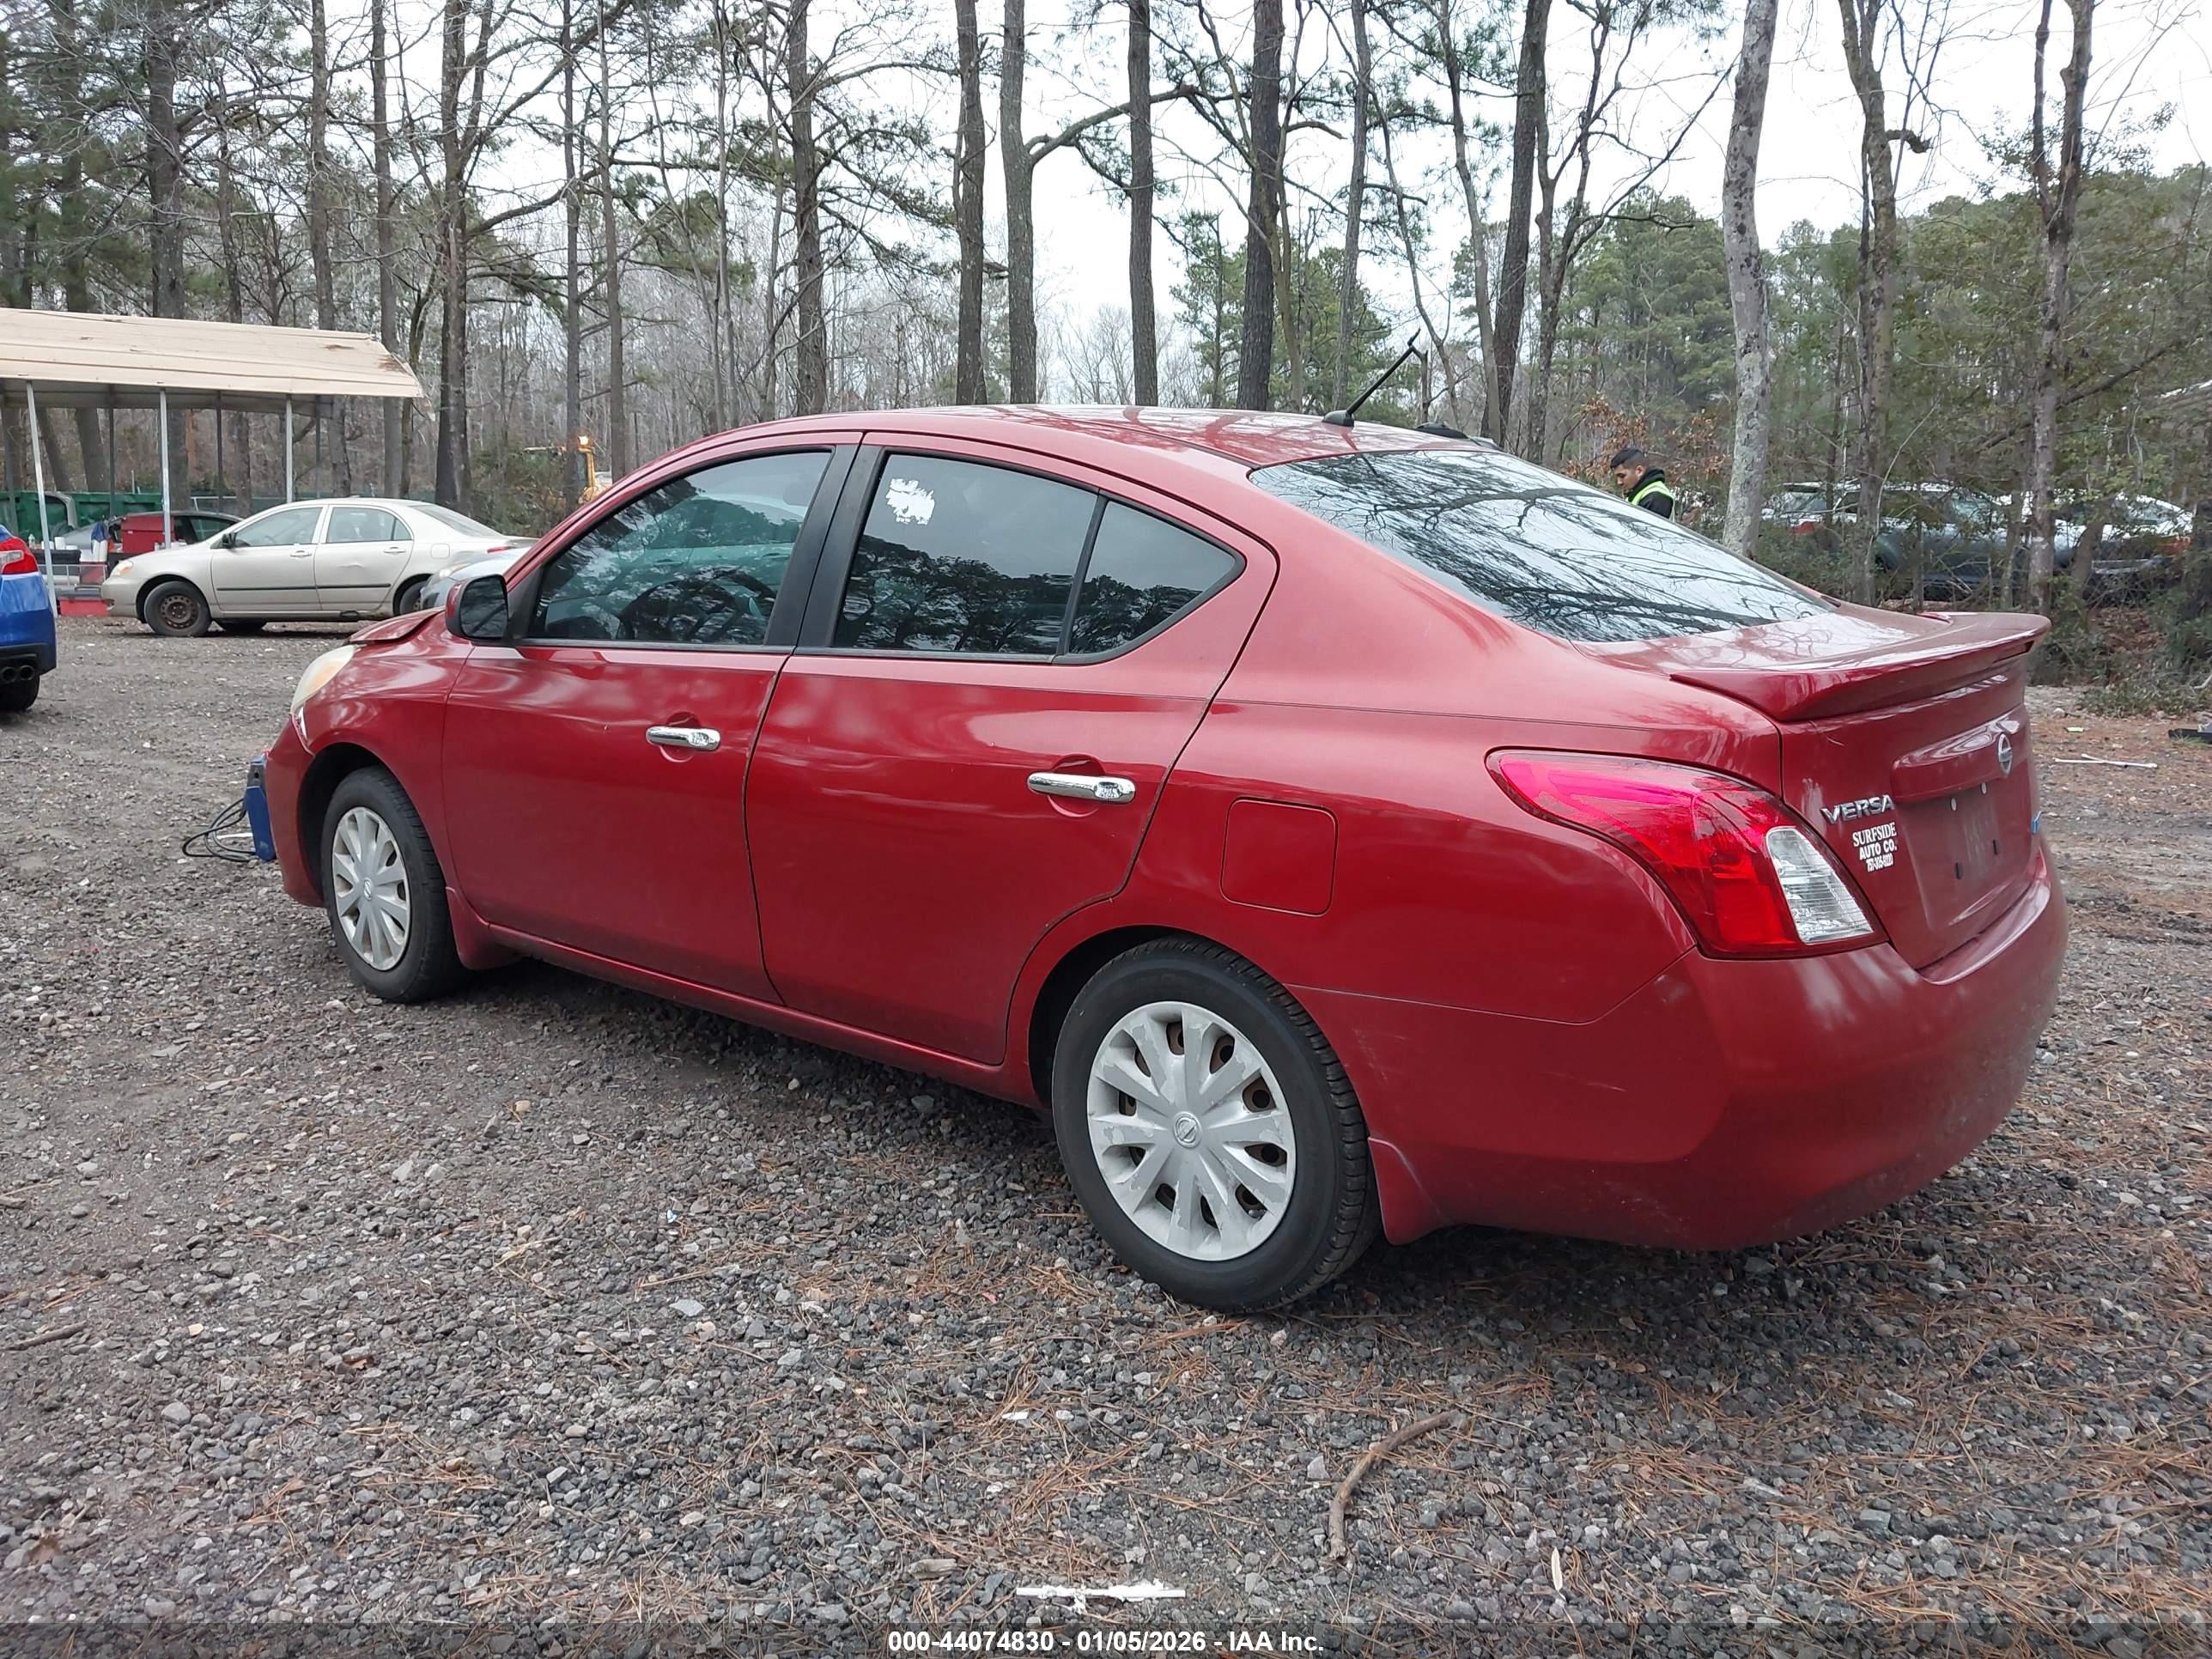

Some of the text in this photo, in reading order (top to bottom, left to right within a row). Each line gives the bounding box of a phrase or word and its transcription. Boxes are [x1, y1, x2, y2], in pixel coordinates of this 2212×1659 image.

[1820, 794, 1894, 824] VERSA
[1852, 822, 1896, 847] SURFSIDE
[1859, 838, 1898, 860] AUTO CO.
